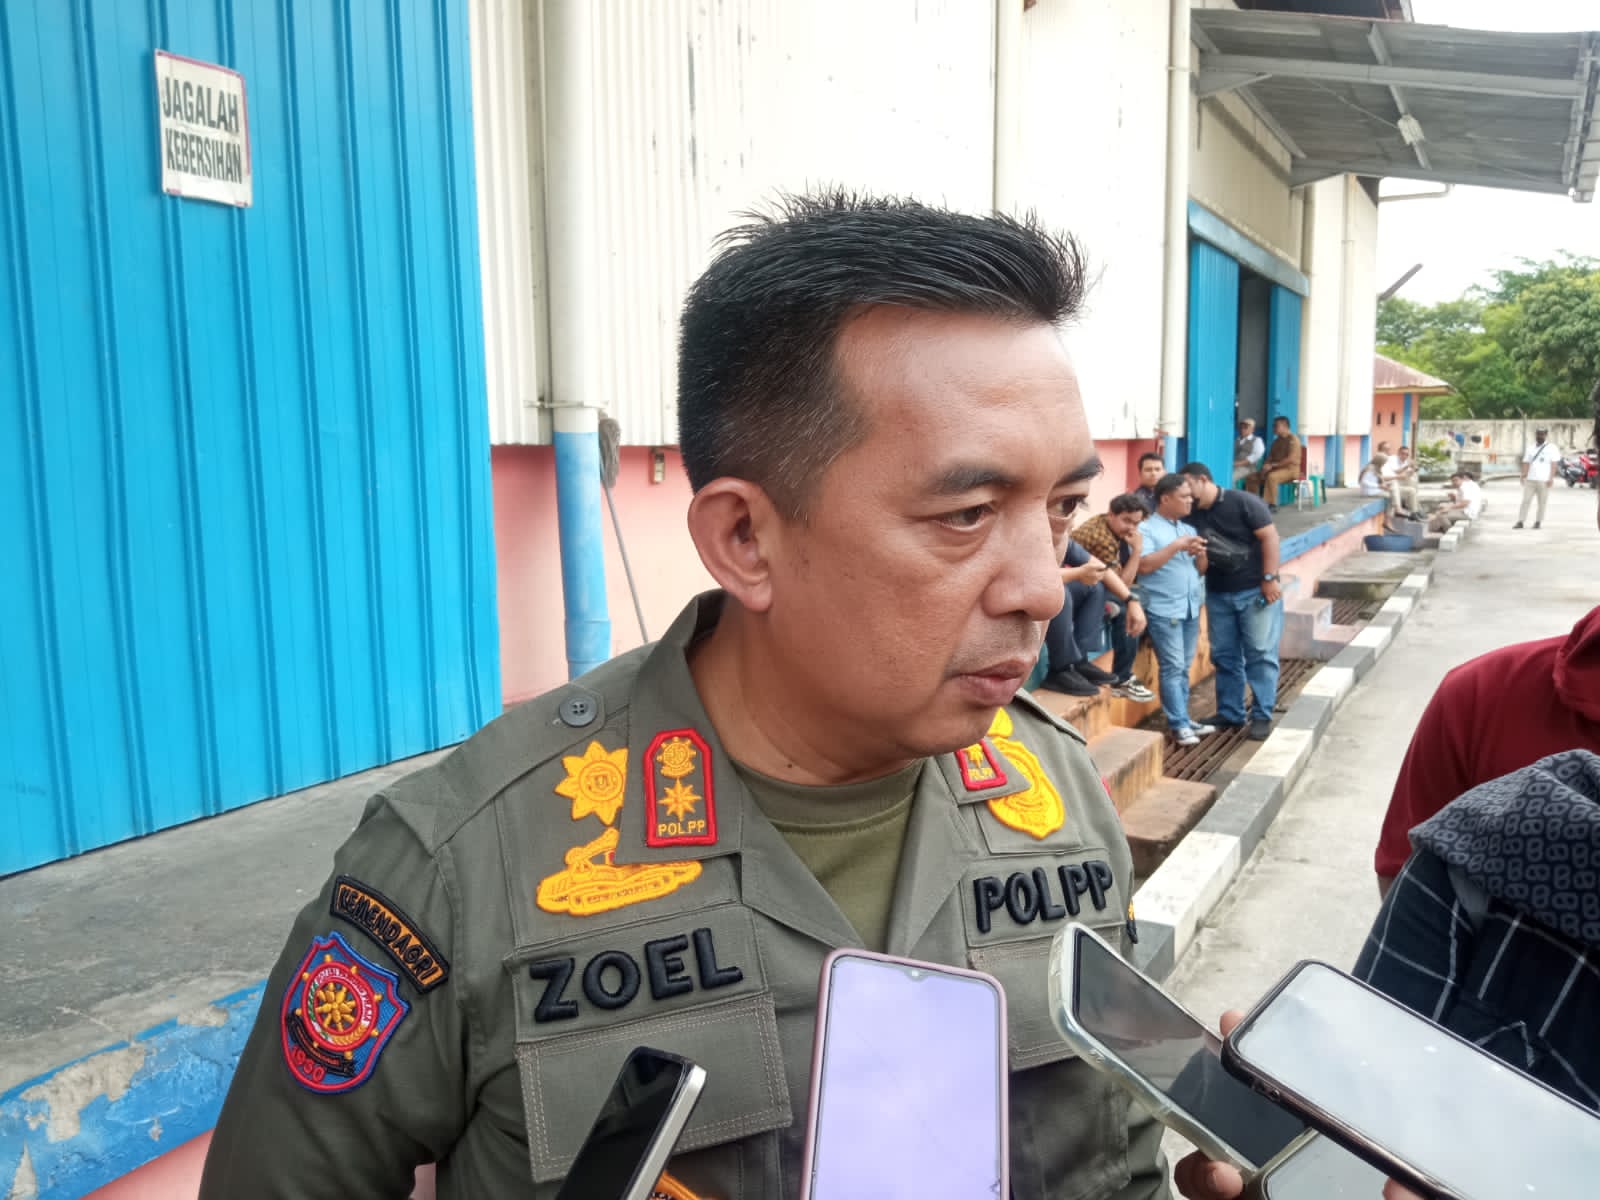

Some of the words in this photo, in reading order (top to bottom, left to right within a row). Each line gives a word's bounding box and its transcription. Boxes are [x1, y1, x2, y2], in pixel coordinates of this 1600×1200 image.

[163, 77, 239, 133] JAGALAH
[165, 127, 242, 184] KEBERSIHAN
[339, 886, 438, 981] KEMENDAGRI
[529, 927, 744, 1023] ZOEL
